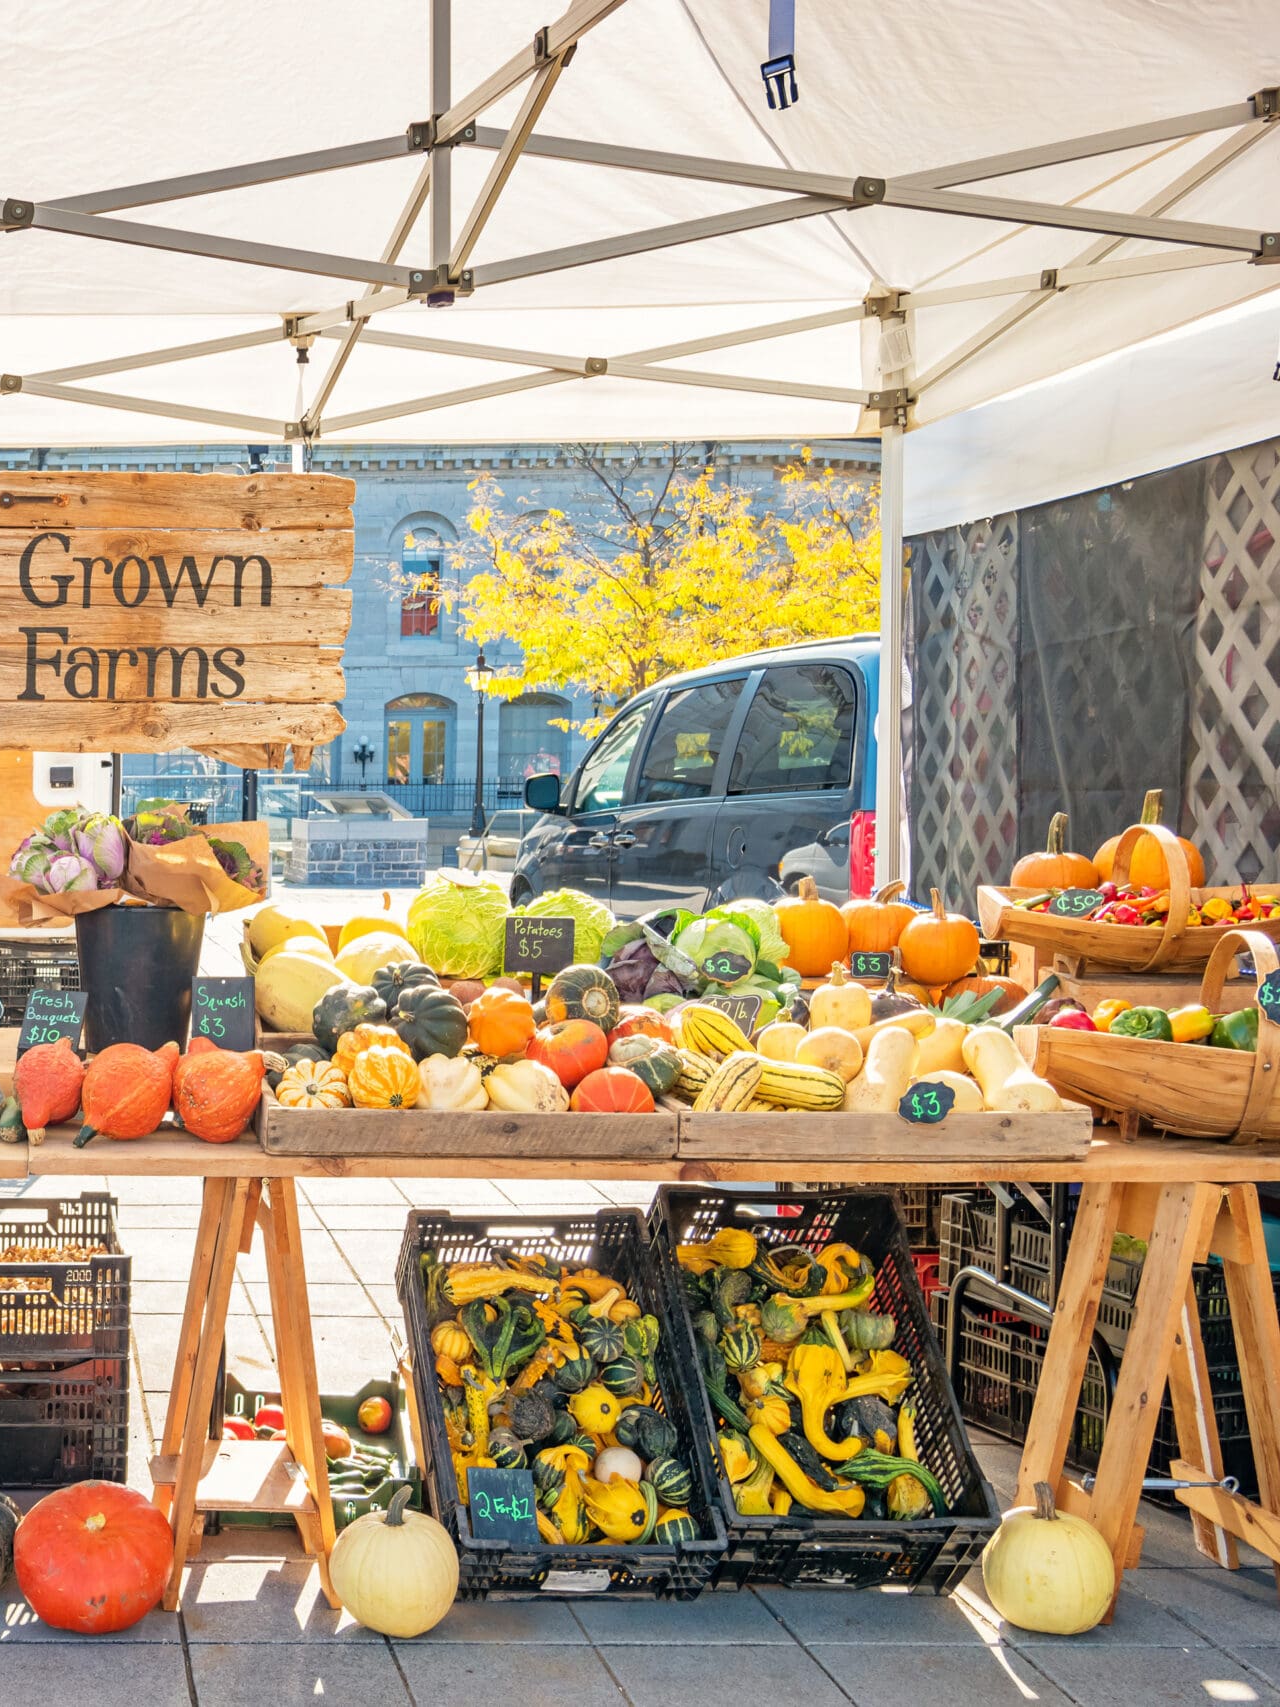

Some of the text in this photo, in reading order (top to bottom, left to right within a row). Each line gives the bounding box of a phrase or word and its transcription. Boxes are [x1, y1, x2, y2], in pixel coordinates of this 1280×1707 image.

[19, 532, 272, 609] Grown
[17, 627, 246, 700] Farms
[514, 918, 563, 939] Potatoes
[518, 936, 544, 959] $5
[705, 958, 740, 975] $2
[857, 954, 881, 973] $3
[30, 989, 74, 1009] Fresh
[197, 985, 246, 1011] Squash
[26, 1006, 81, 1026] Bouquets
[199, 1013, 225, 1037] $3
[26, 1025, 60, 1044] $10
[911, 1091, 941, 1119] $3
[475, 1491, 495, 1521] 2
